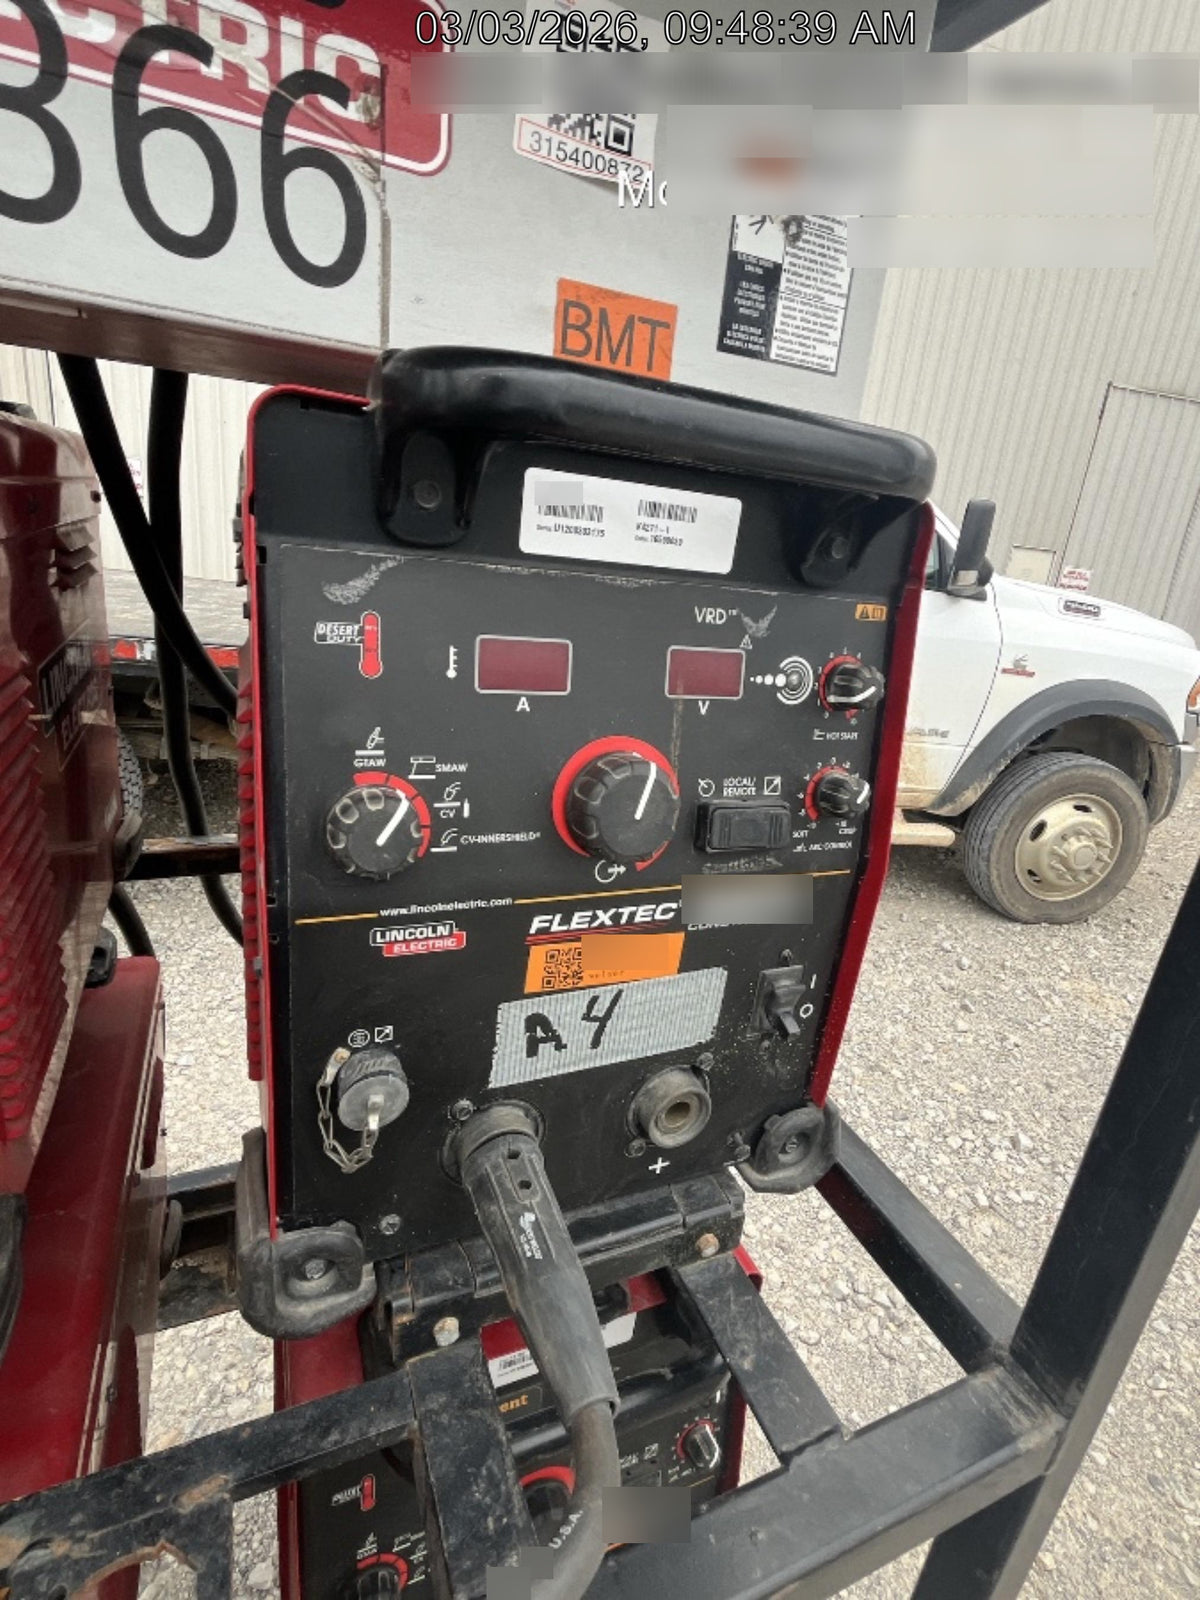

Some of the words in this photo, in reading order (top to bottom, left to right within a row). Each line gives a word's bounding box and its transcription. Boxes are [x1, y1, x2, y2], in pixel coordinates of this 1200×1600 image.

[529, 130, 645, 182] 315400872
[560, 298, 671, 372] BMT
[317, 623, 359, 636] DESERT
[515, 696, 531, 712] A
[698, 700, 710, 716] V
[353, 758, 387, 768] GTAW
[434, 763, 468, 773] SMAW
[440, 809, 456, 819] CV
[379, 896, 514, 918] www.lincolnelectric.com
[375, 924, 451, 944] LINCOLN
[393, 936, 458, 954] ELECTRIC
[549, 1508, 585, 1550] U.S.A.
